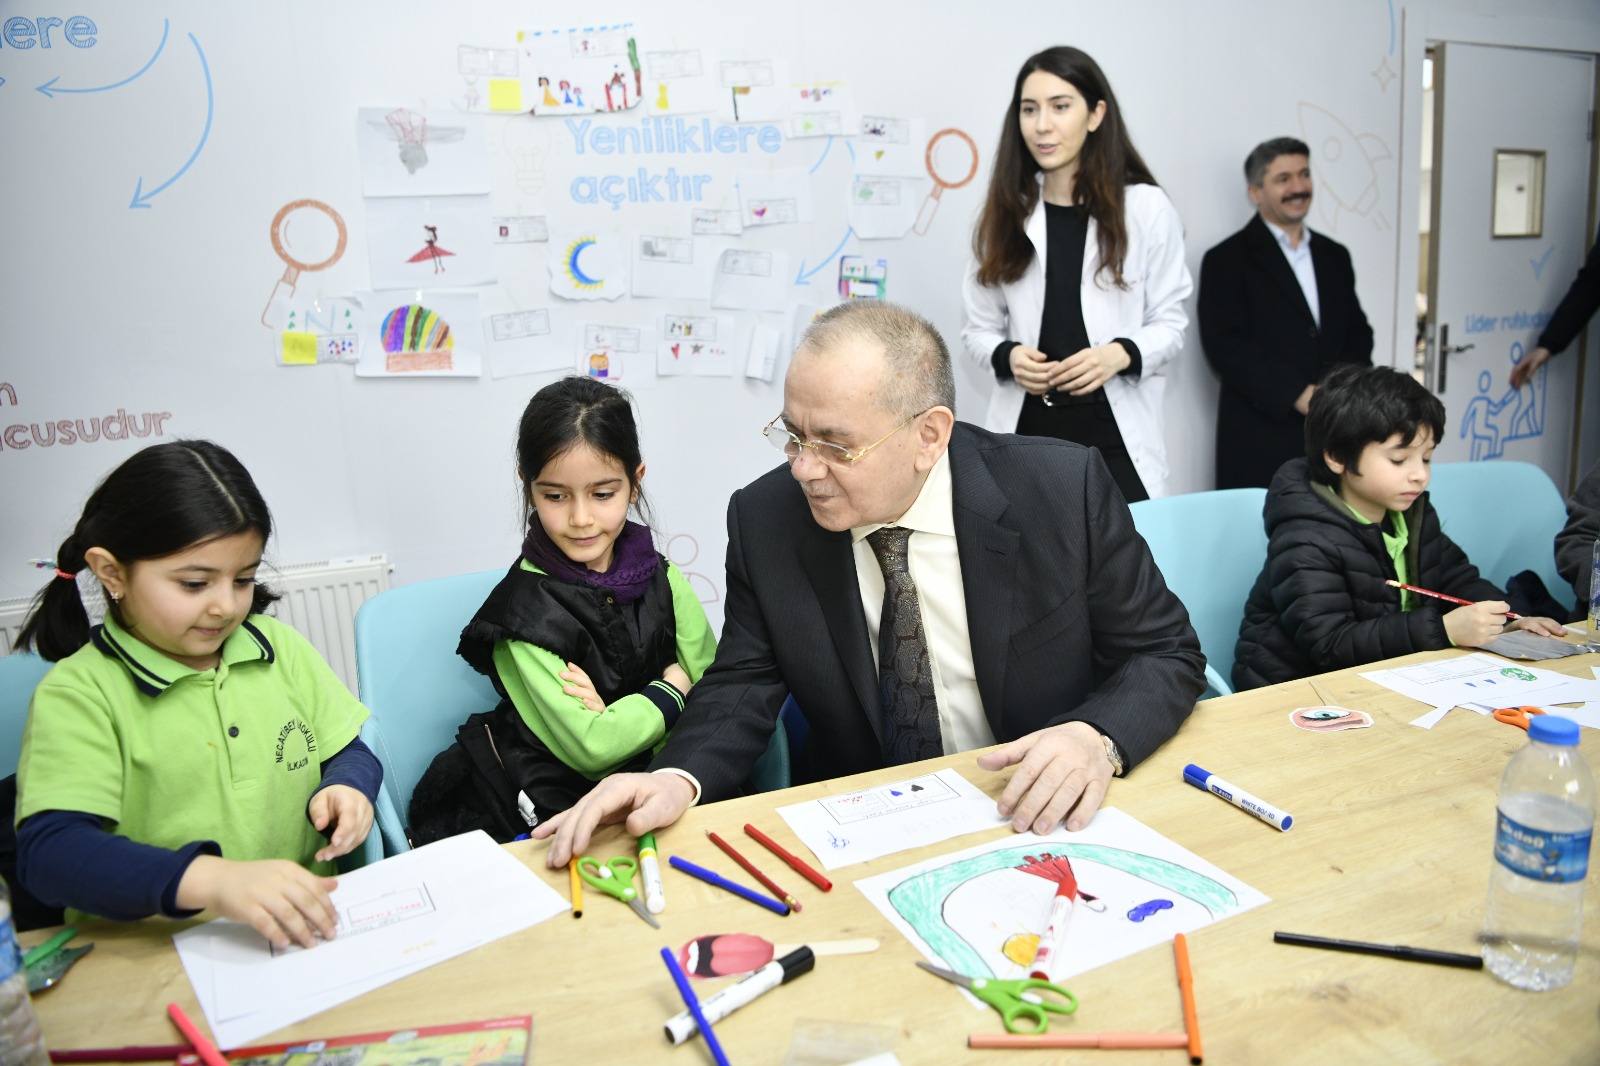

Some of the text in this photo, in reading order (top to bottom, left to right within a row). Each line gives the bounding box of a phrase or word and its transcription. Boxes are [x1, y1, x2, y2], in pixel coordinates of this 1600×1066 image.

[0, 15, 98, 50] ere
[564, 116, 782, 155] Yeniliklere
[569, 167, 713, 211] açıktır
[0, 408, 172, 450] cusudur
[1242, 798, 1256, 810] WHITE
